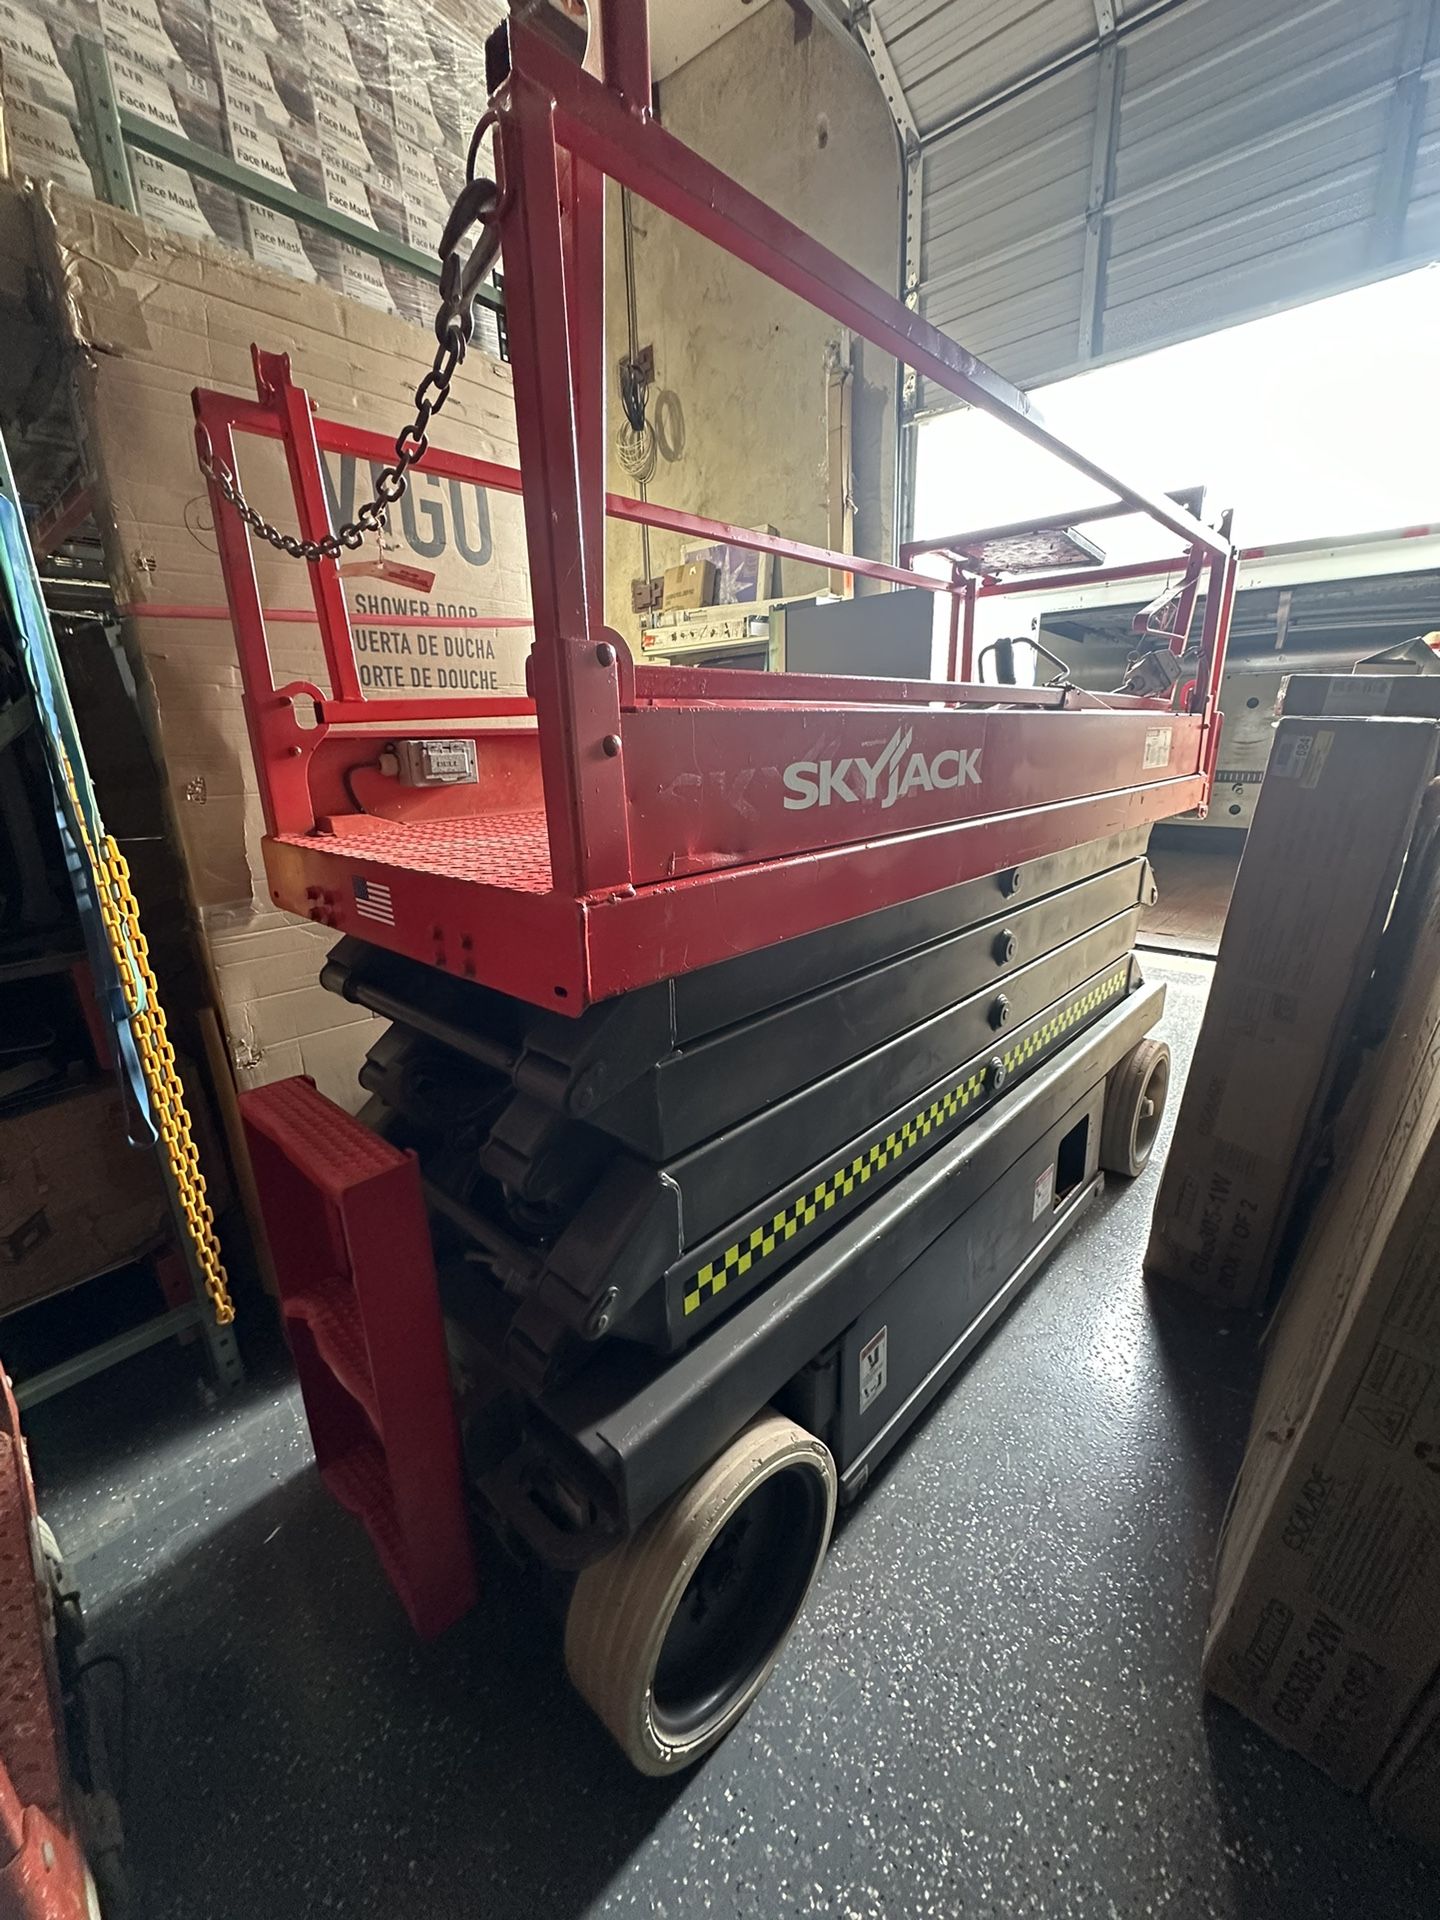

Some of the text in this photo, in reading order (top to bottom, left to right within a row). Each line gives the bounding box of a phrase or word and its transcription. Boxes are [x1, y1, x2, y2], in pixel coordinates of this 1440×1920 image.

[130, 8, 161, 33] Mask
[114, 61, 144, 85] FLTR
[223, 58, 247, 80] Face
[249, 70, 274, 93] Mask
[118, 88, 178, 127] Face Mask
[228, 94, 253, 115] FLTR
[232, 121, 259, 143] FLTR
[318, 111, 340, 131] Face
[339, 120, 361, 140] Mask
[11, 126, 42, 148] Face
[45, 140, 80, 163] Mask
[135, 152, 165, 173] FLTR
[237, 148, 287, 179] Face Mask
[325, 168, 347, 187] FLTR
[139, 178, 167, 199] Face
[168, 189, 198, 213] Mask
[329, 191, 371, 220] Face Mask
[254, 228, 277, 245] Face
[278, 236, 302, 256] Mask
[343, 265, 384, 289] Face Mask
[355, 594, 430, 619] SHOWER
[351, 629, 496, 661] UERTA DE DUCHA
[360, 664, 499, 691] ORTE DE DOUCHE
[783, 726, 983, 810] SKYJACK
[1240, 1198, 1258, 1213] 2
[1231, 1211, 1252, 1240] OF
[1281, 1462, 1335, 1553] ESCALADE
